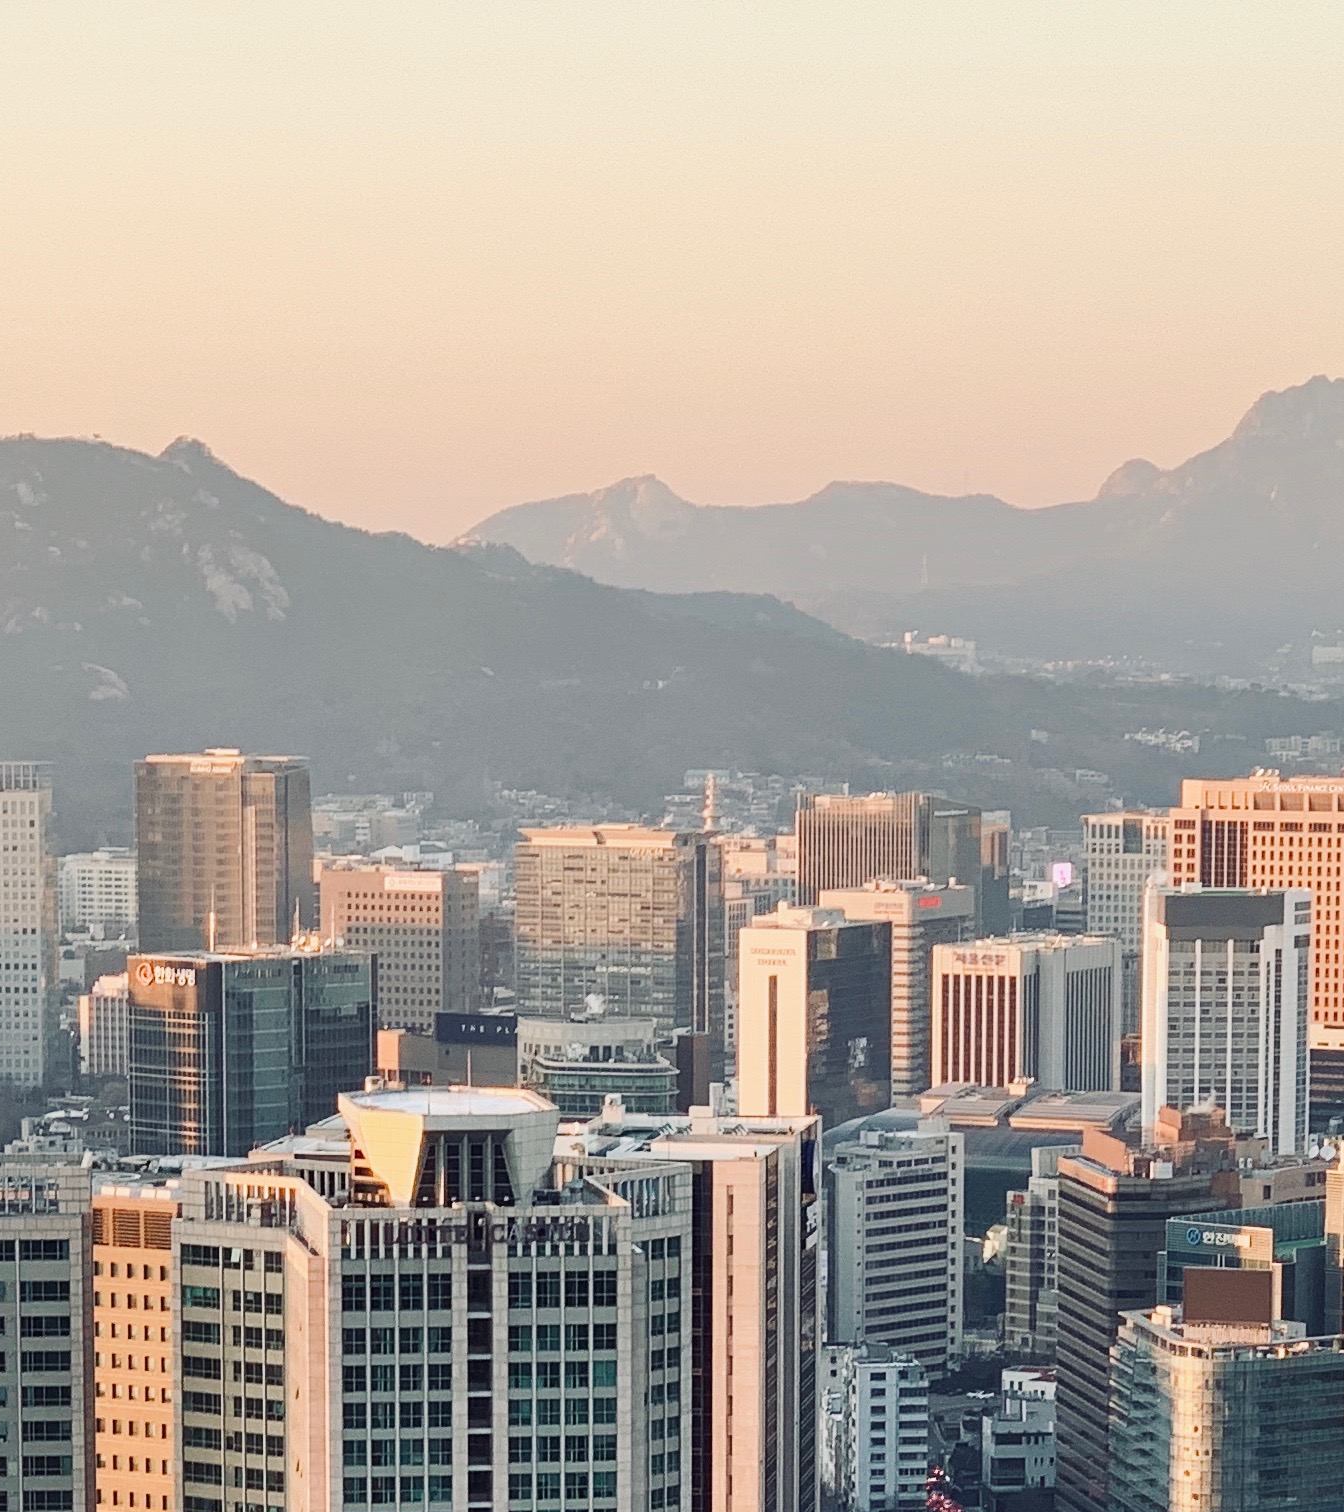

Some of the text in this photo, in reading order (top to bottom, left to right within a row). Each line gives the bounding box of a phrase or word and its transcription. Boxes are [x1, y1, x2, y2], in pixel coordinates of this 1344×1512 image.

[1298, 785, 1327, 794] FINANCE
[154, 966, 196, 987] 한화생명
[461, 1024, 485, 1034] THE
